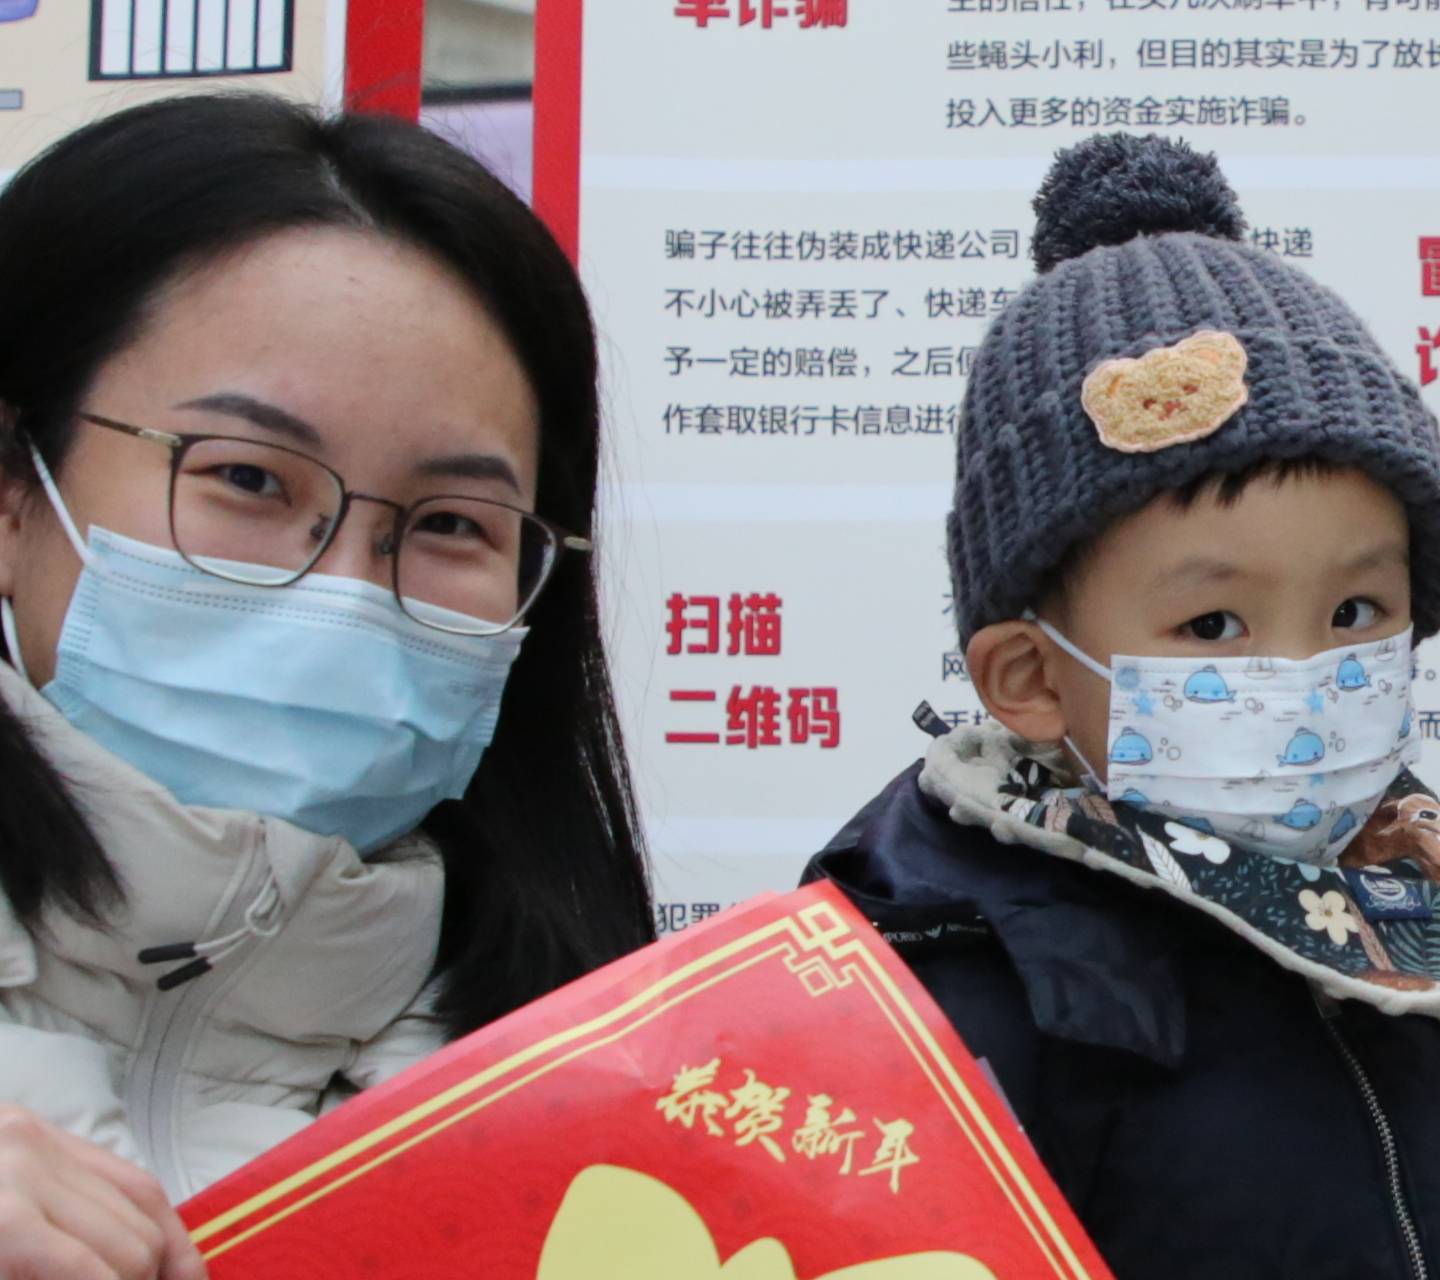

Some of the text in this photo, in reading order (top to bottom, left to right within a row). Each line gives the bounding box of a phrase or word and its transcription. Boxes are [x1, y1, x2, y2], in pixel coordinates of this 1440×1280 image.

[947, 96, 1307, 128] 投入更多的资金实施诈骗。
[664, 229, 1020, 261] 骗子往往伪装成快递公司
[666, 592, 783, 656] 扫描
[665, 685, 841, 750] 二维码
[655, 1057, 920, 1195] 恭贺新年
